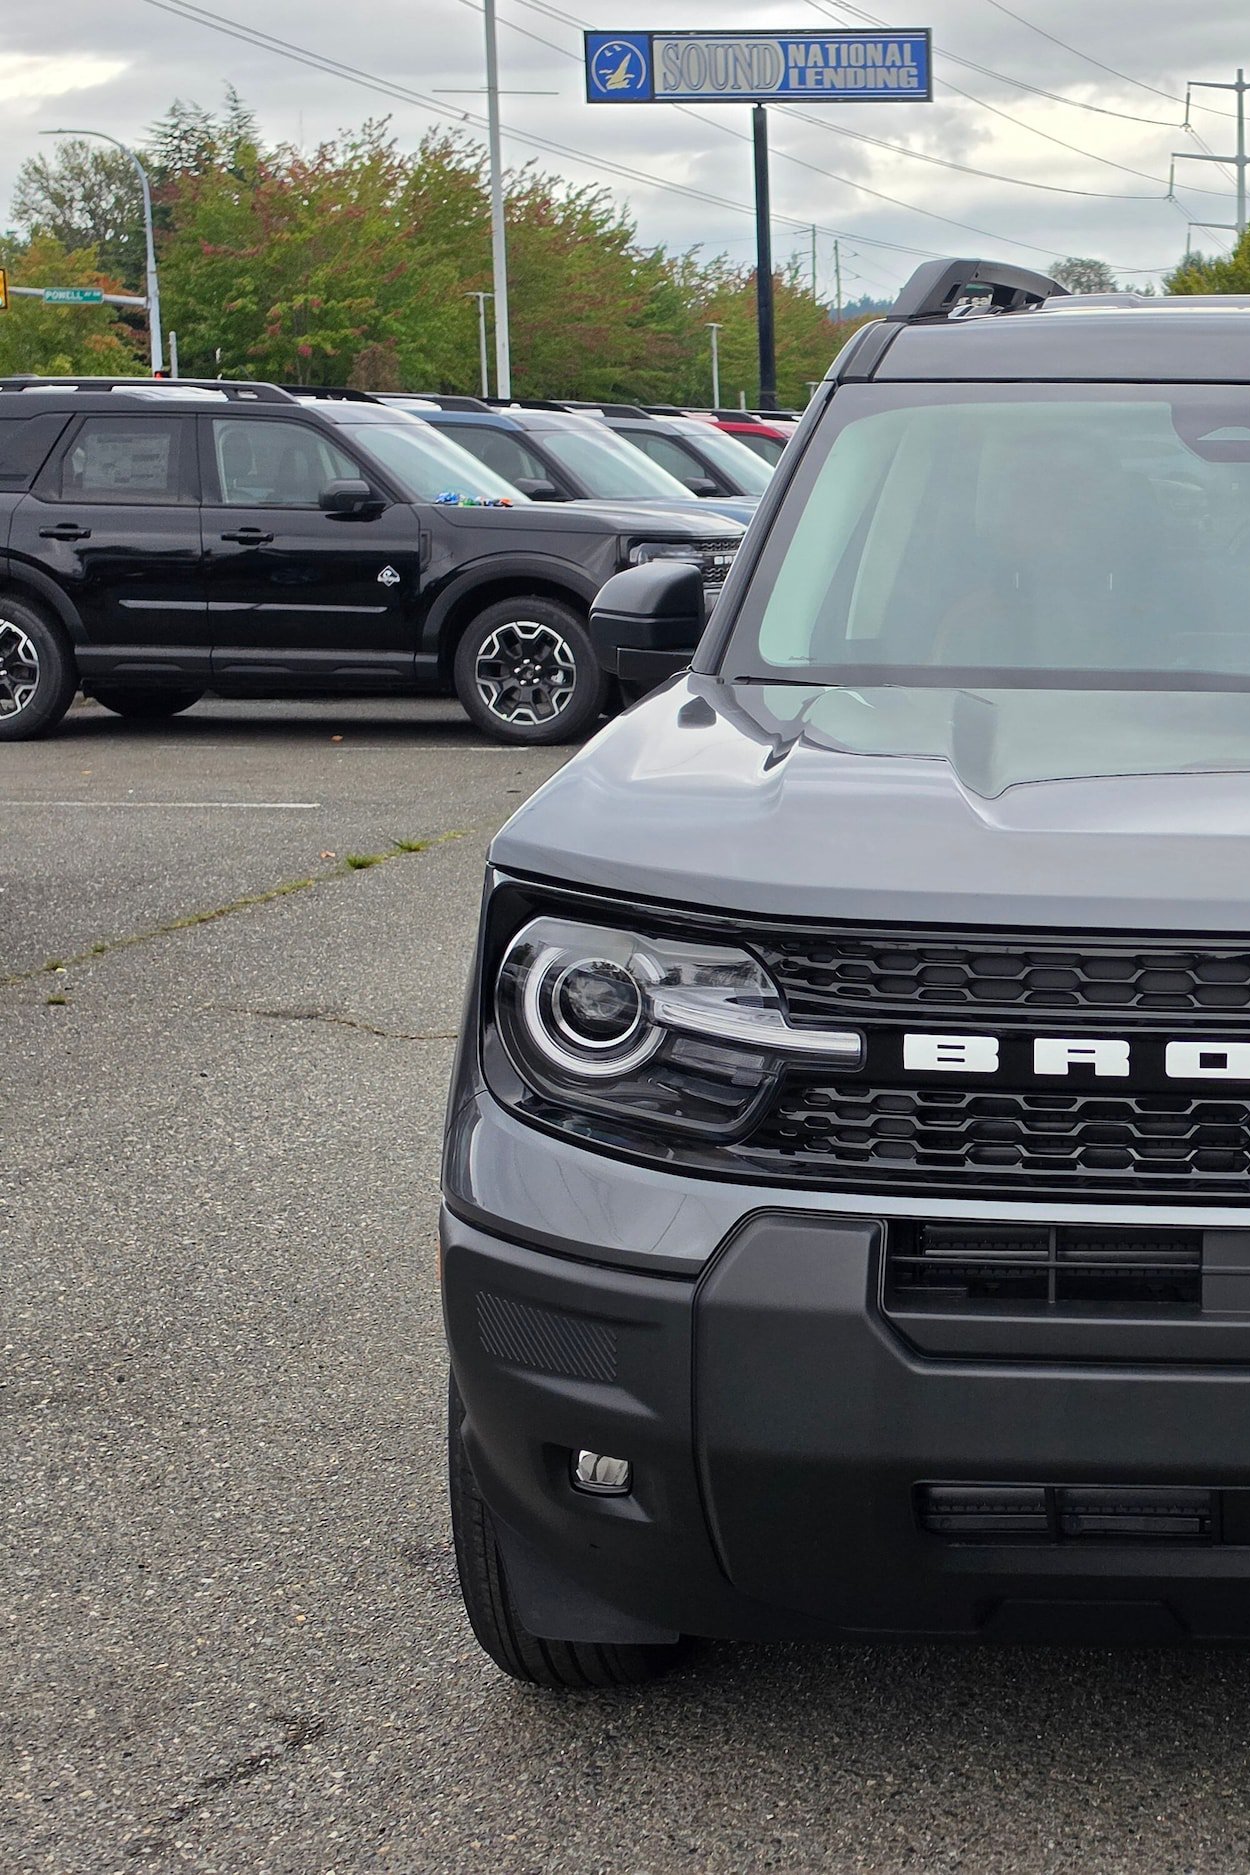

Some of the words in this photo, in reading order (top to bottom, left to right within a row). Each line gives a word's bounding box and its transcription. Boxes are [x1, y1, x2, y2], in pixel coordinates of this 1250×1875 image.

[662, 42, 782, 91] SOUND
[788, 43, 917, 67] NATIONAL
[788, 67, 919, 90] LENDING
[45, 290, 83, 300] POWELL
